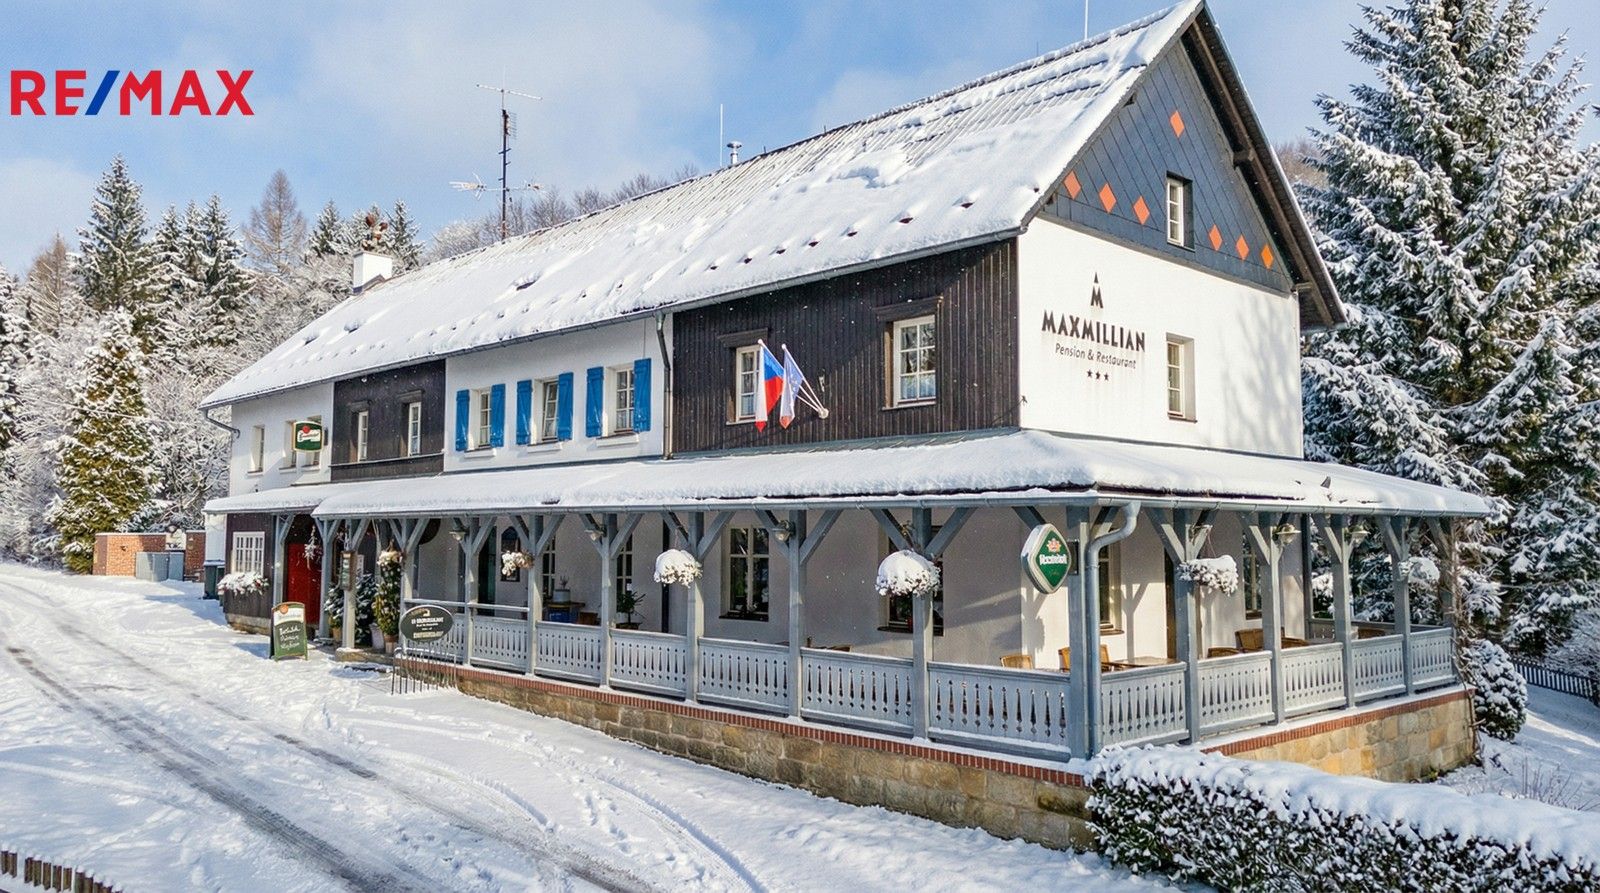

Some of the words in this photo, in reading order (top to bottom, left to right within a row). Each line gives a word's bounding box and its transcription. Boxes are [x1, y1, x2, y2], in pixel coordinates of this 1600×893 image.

[1041, 309, 1146, 352] MAXMILLIAN
[1055, 342, 1086, 360] Pension
[1087, 349, 1095, 361] &
[1096, 351, 1137, 369] Restaurant
